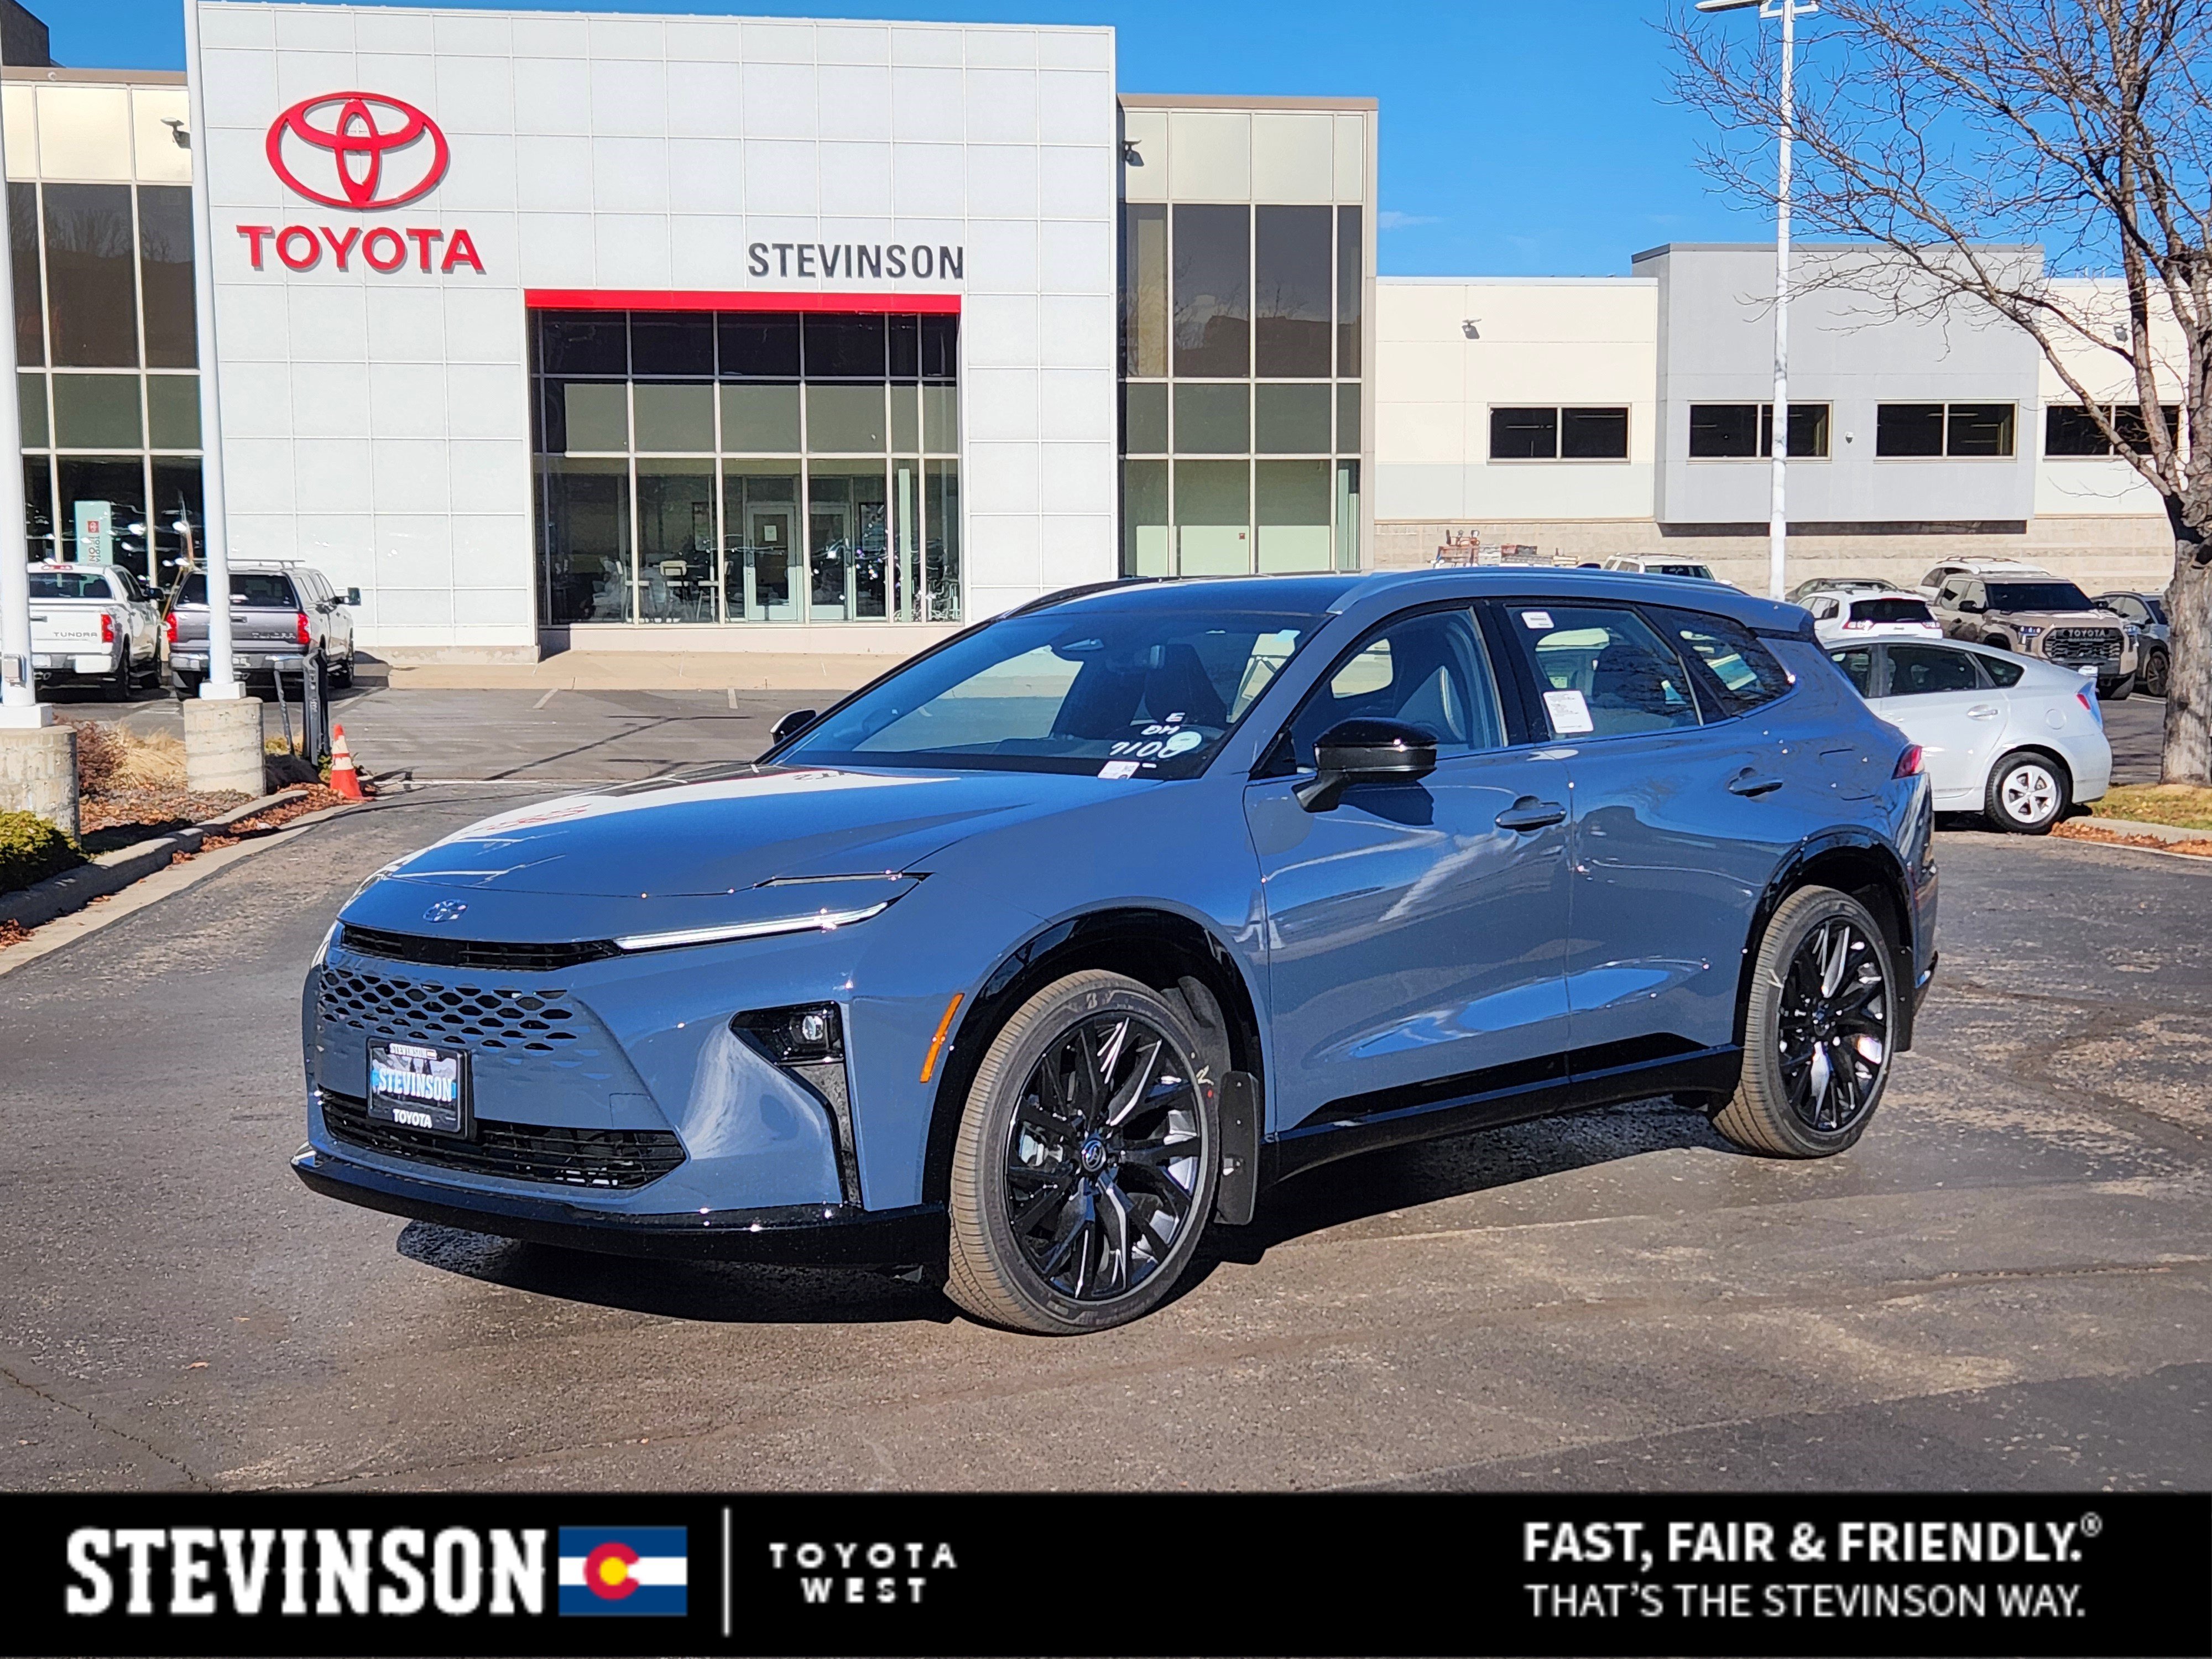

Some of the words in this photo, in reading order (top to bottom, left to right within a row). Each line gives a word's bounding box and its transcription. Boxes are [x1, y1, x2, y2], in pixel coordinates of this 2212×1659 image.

[237, 225, 486, 274] TOYOTA
[748, 242, 963, 280] STEVINSON
[379, 1067, 452, 1102] STEVINSON
[392, 1108, 432, 1129] TOYOTA
